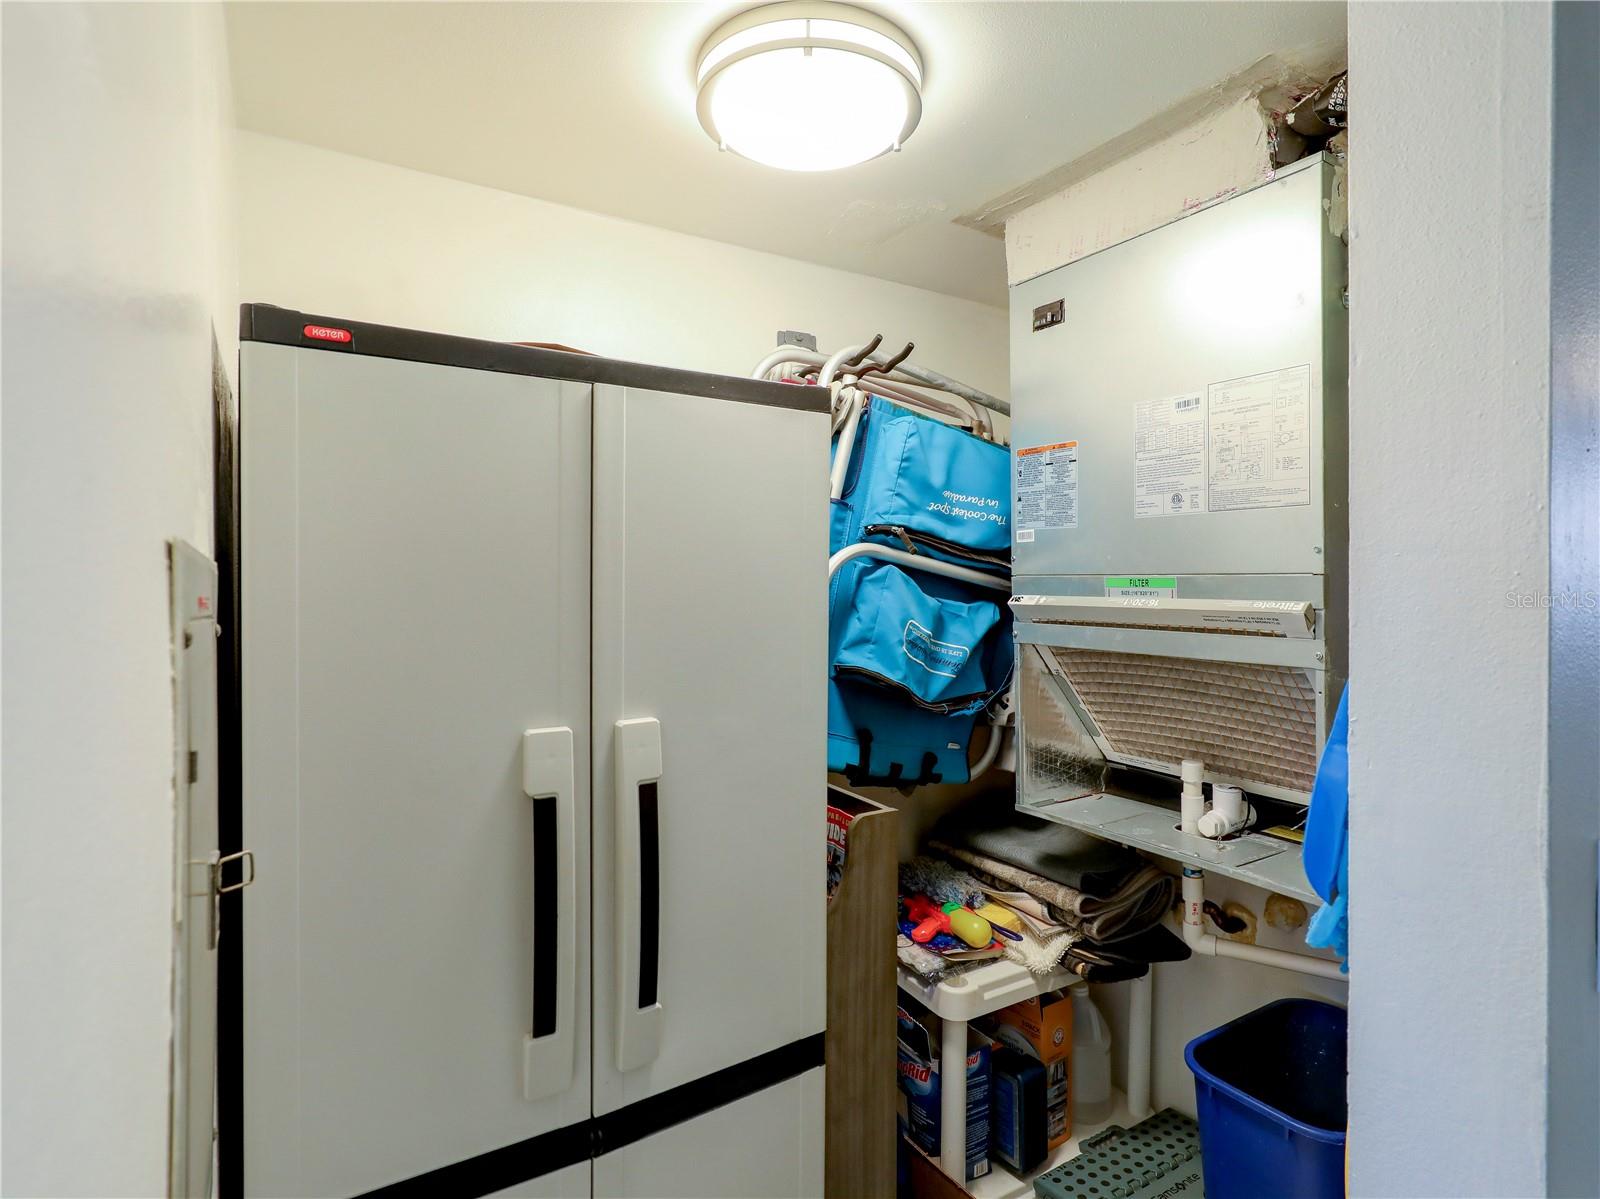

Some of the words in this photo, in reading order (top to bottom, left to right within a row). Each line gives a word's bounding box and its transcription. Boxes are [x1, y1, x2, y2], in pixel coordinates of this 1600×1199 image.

[942, 490, 985, 506] Paradise
[986, 499, 999, 508] in
[927, 502, 950, 515] Spot
[951, 507, 987, 521] Coolest
[988, 513, 1006, 525] The
[1129, 579, 1150, 587] FILTER
[827, 822, 847, 846] IDE
